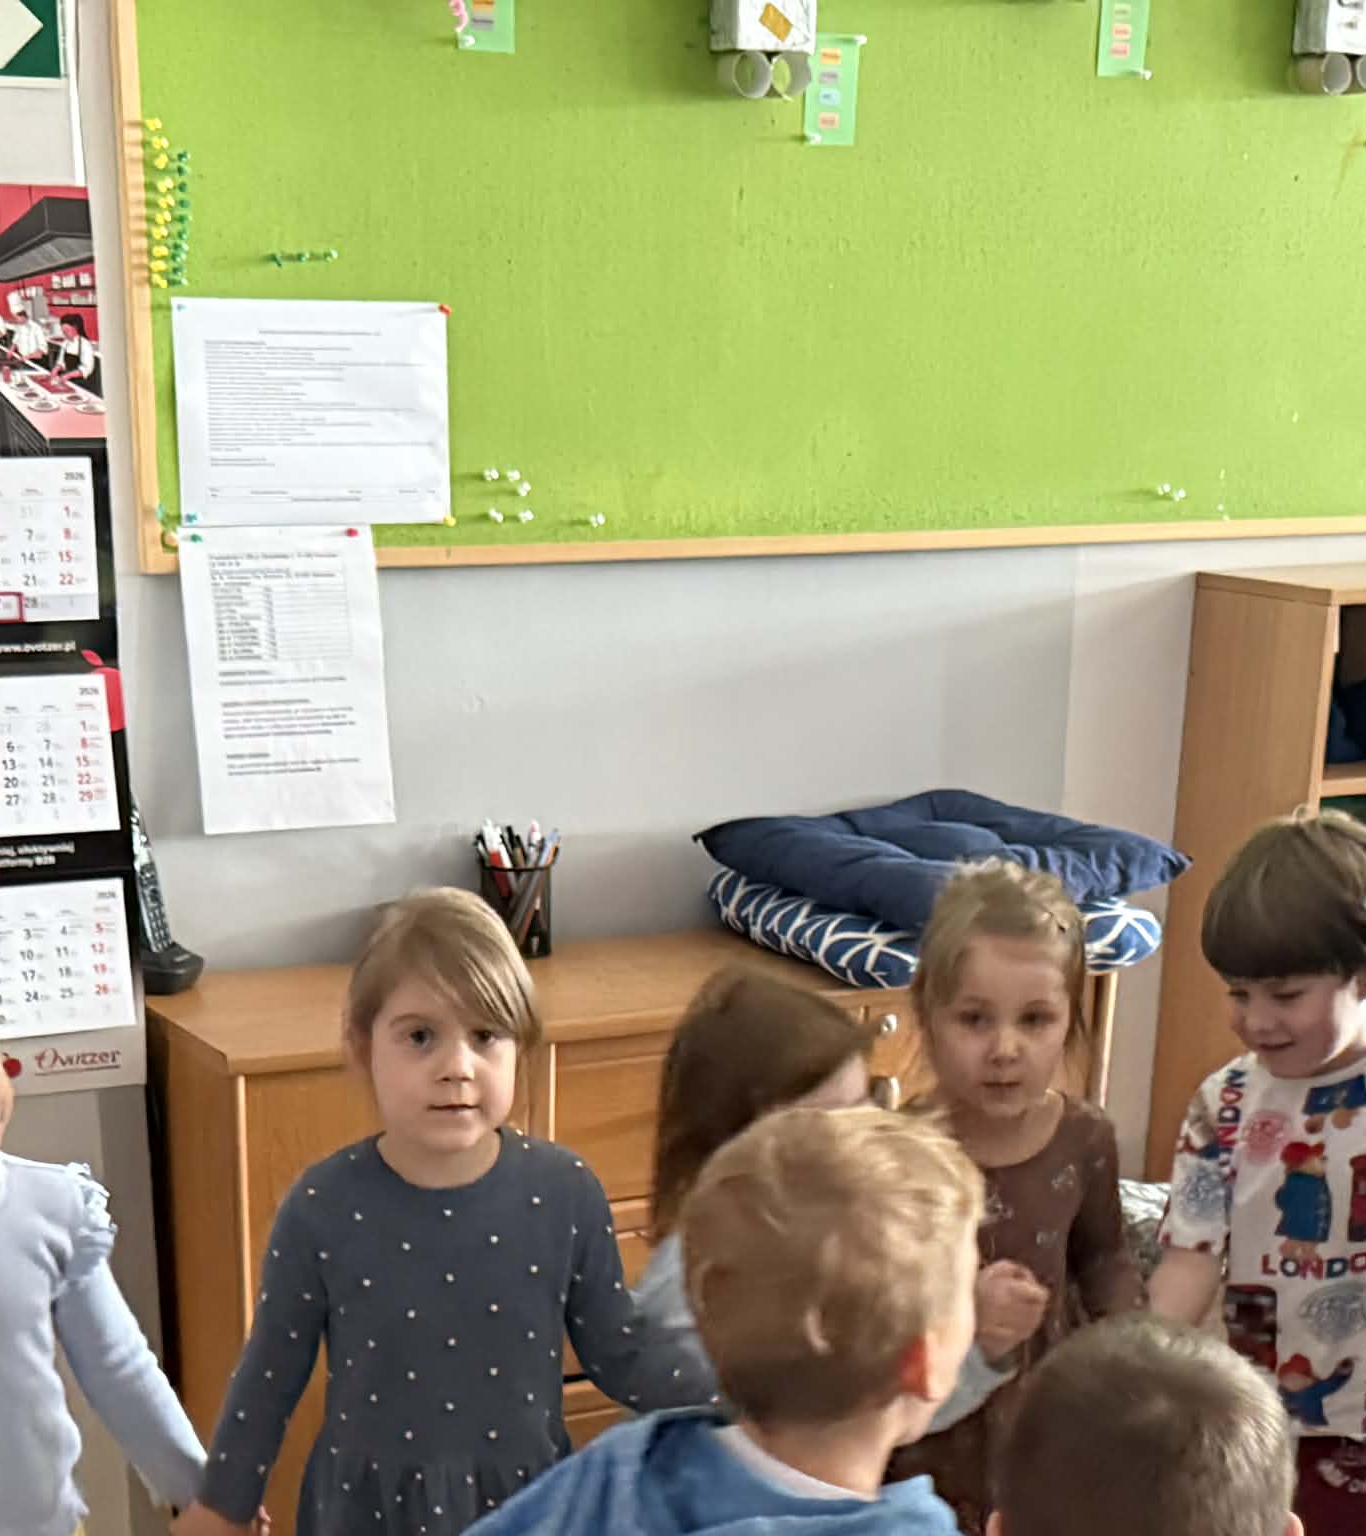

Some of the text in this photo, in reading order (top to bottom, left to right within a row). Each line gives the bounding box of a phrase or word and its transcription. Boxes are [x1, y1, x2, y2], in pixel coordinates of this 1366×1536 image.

[25, 528, 34, 541] 7
[21, 552, 36, 564] 14
[58, 551, 72, 563] 15
[23, 574, 37, 587] 21
[59, 573, 74, 585] 22
[6, 741, 15, 753] 6
[44, 739, 51, 751] 7
[2, 758, 16, 770] 13
[39, 757, 53, 768] 14
[76, 755, 90, 767] 15
[4, 777, 19, 789] 20
[42, 775, 56, 787] 21
[77, 773, 92, 785] 22
[5, 794, 20, 806] 27
[42, 792, 56, 804] 28
[79, 790, 93, 802] 29
[24, 929, 31, 940] 3
[61, 925, 68, 936] 4
[96, 922, 104, 933] 5
[20, 950, 34, 961] 10
[56, 947, 69, 957] 11
[92, 943, 105, 953] 12
[22, 970, 35, 981] 17
[59, 967, 72, 977] 18
[93, 963, 107, 974] 19
[25, 991, 39, 1002] 24
[60, 988, 74, 998] 25
[95, 984, 109, 995] 26
